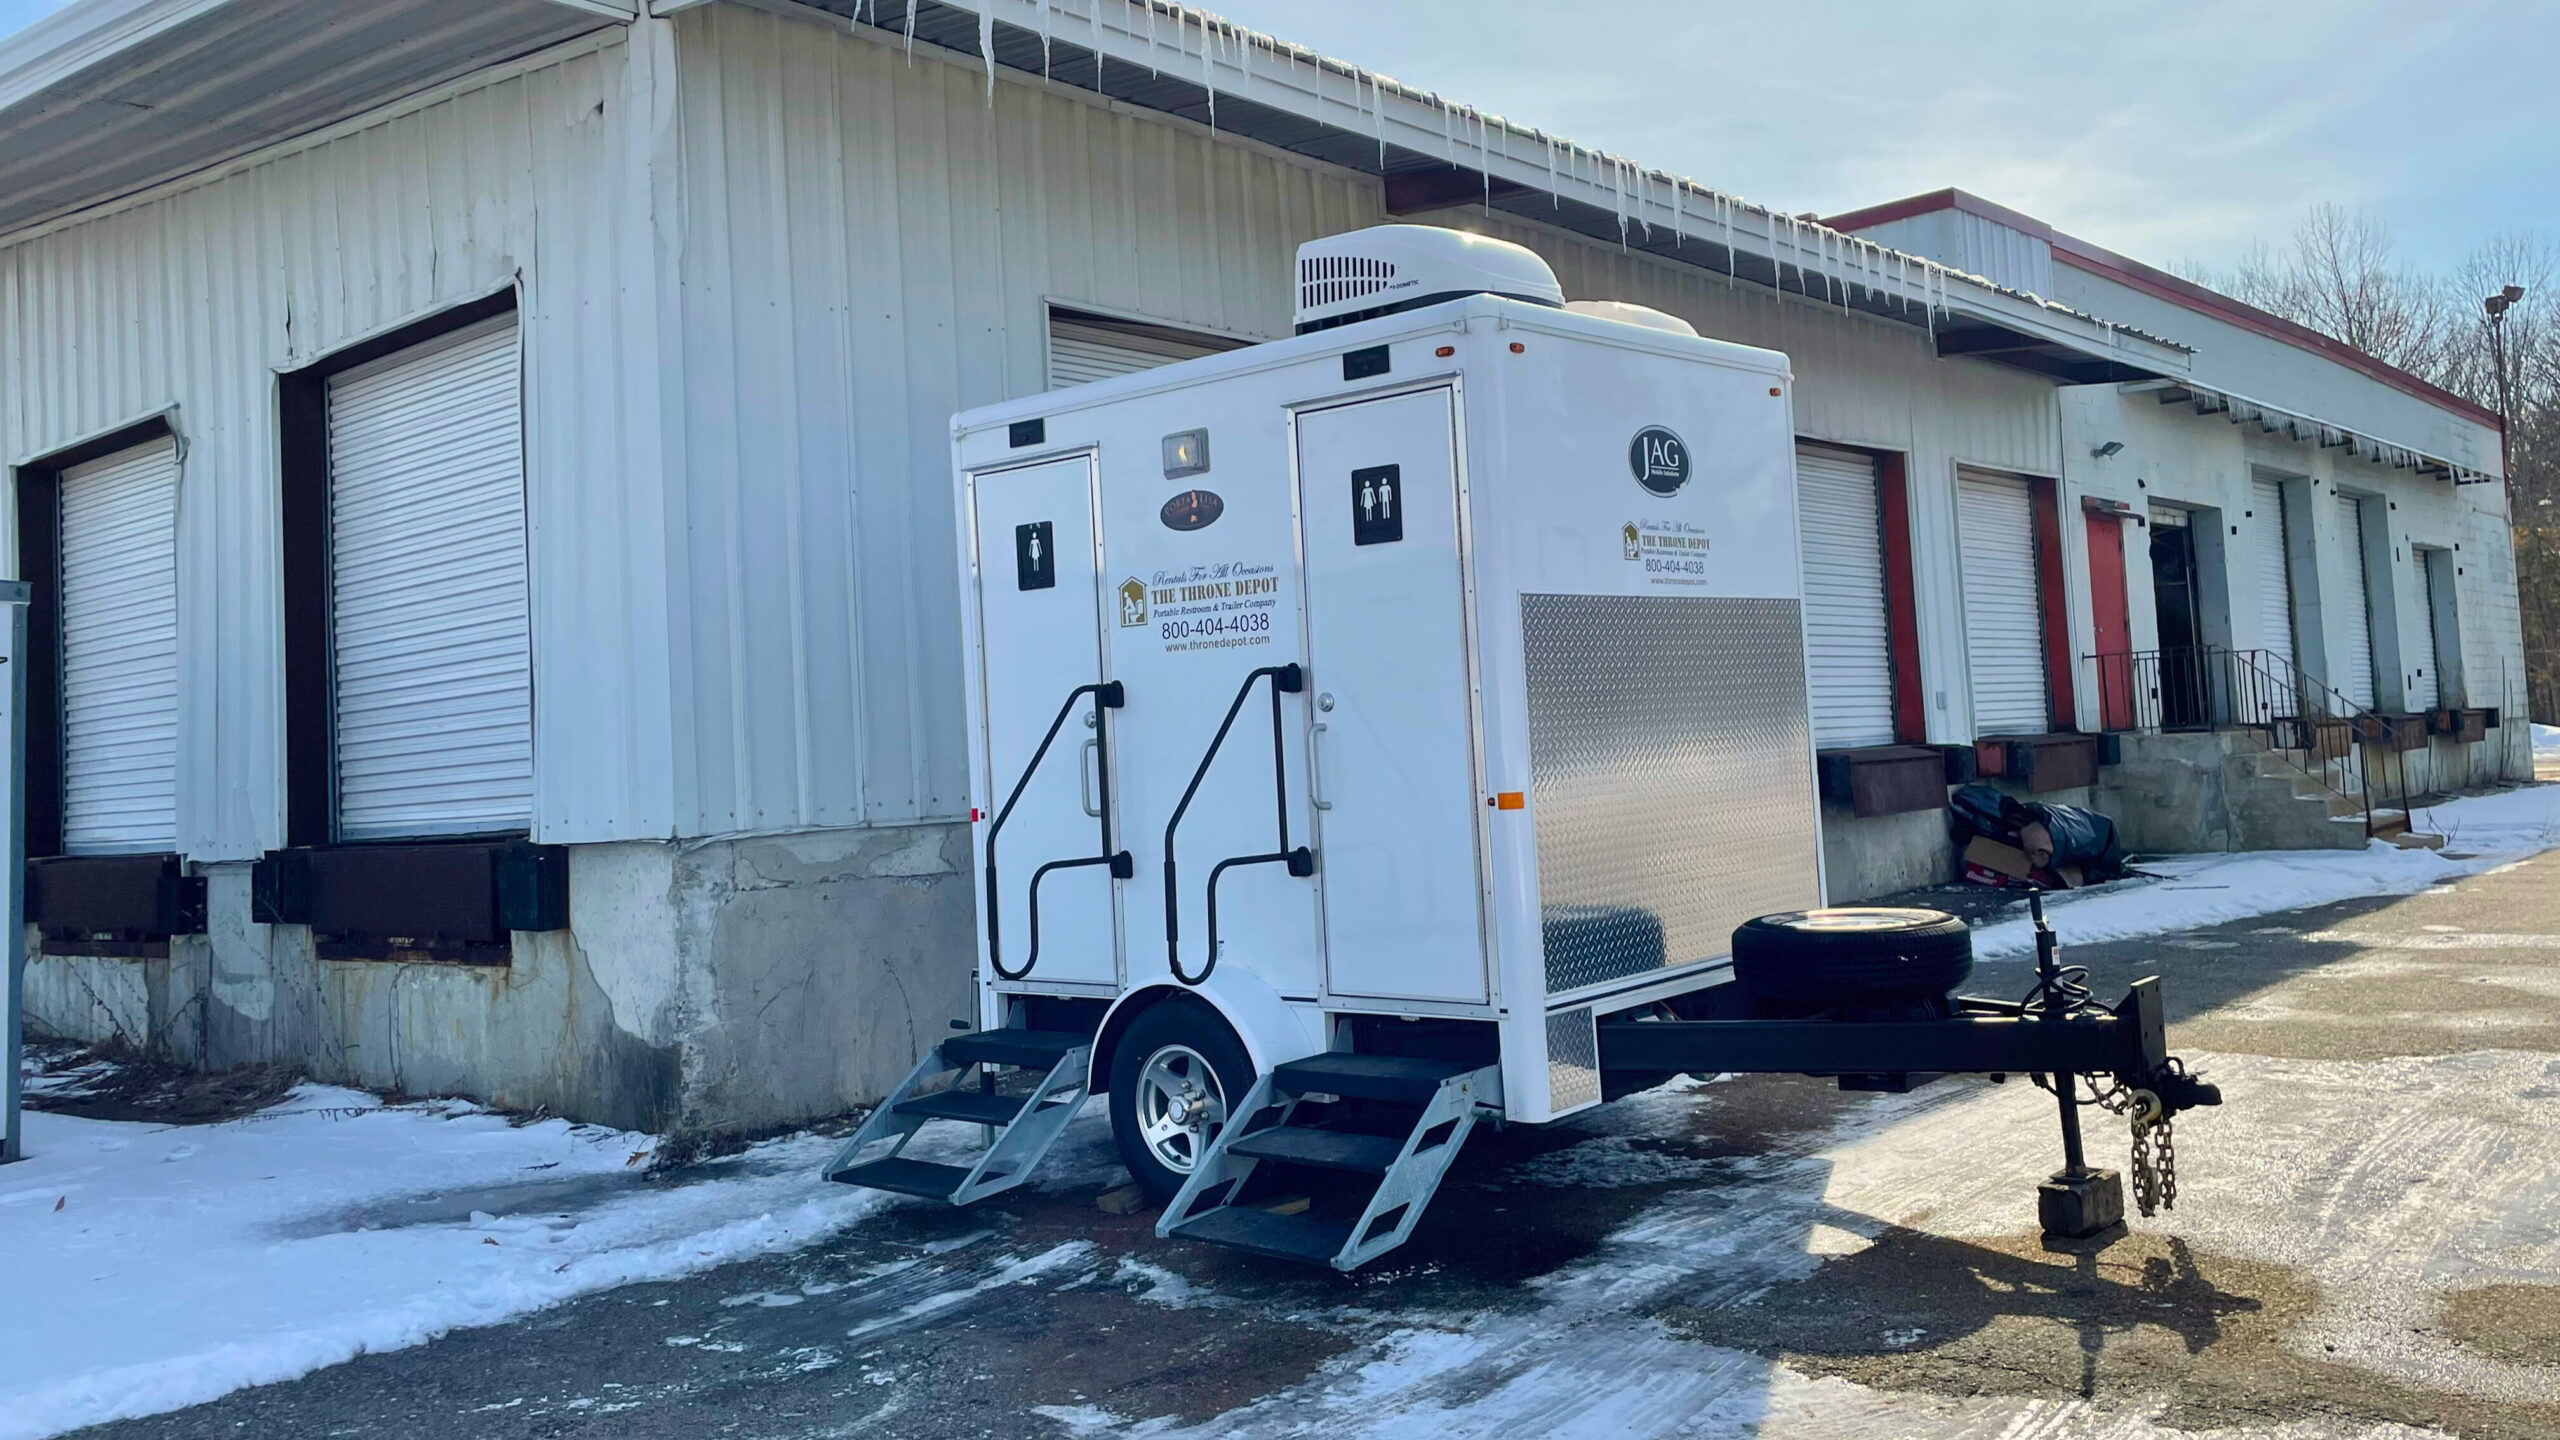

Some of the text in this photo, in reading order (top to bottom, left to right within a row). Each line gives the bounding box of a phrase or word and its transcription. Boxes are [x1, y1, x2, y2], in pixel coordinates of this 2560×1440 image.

[1396, 280, 1419, 289] DOMETIC
[1642, 436, 1679, 480] JAG
[1642, 535, 1710, 550] THE THRONE DEPOT
[1152, 561, 1274, 586] Rentals For All Occasions
[1646, 558, 1704, 574] 800-404-4038
[1151, 577, 1278, 605] THE THRONE DEPOT
[1153, 607, 1180, 618] Portable
[1181, 605, 1212, 616] Restroom
[1221, 601, 1242, 611] Trailer
[1244, 599, 1276, 609] Company
[1162, 612, 1270, 640] 800-404-4038
[1165, 635, 1270, 652] www.thronedepot.com
